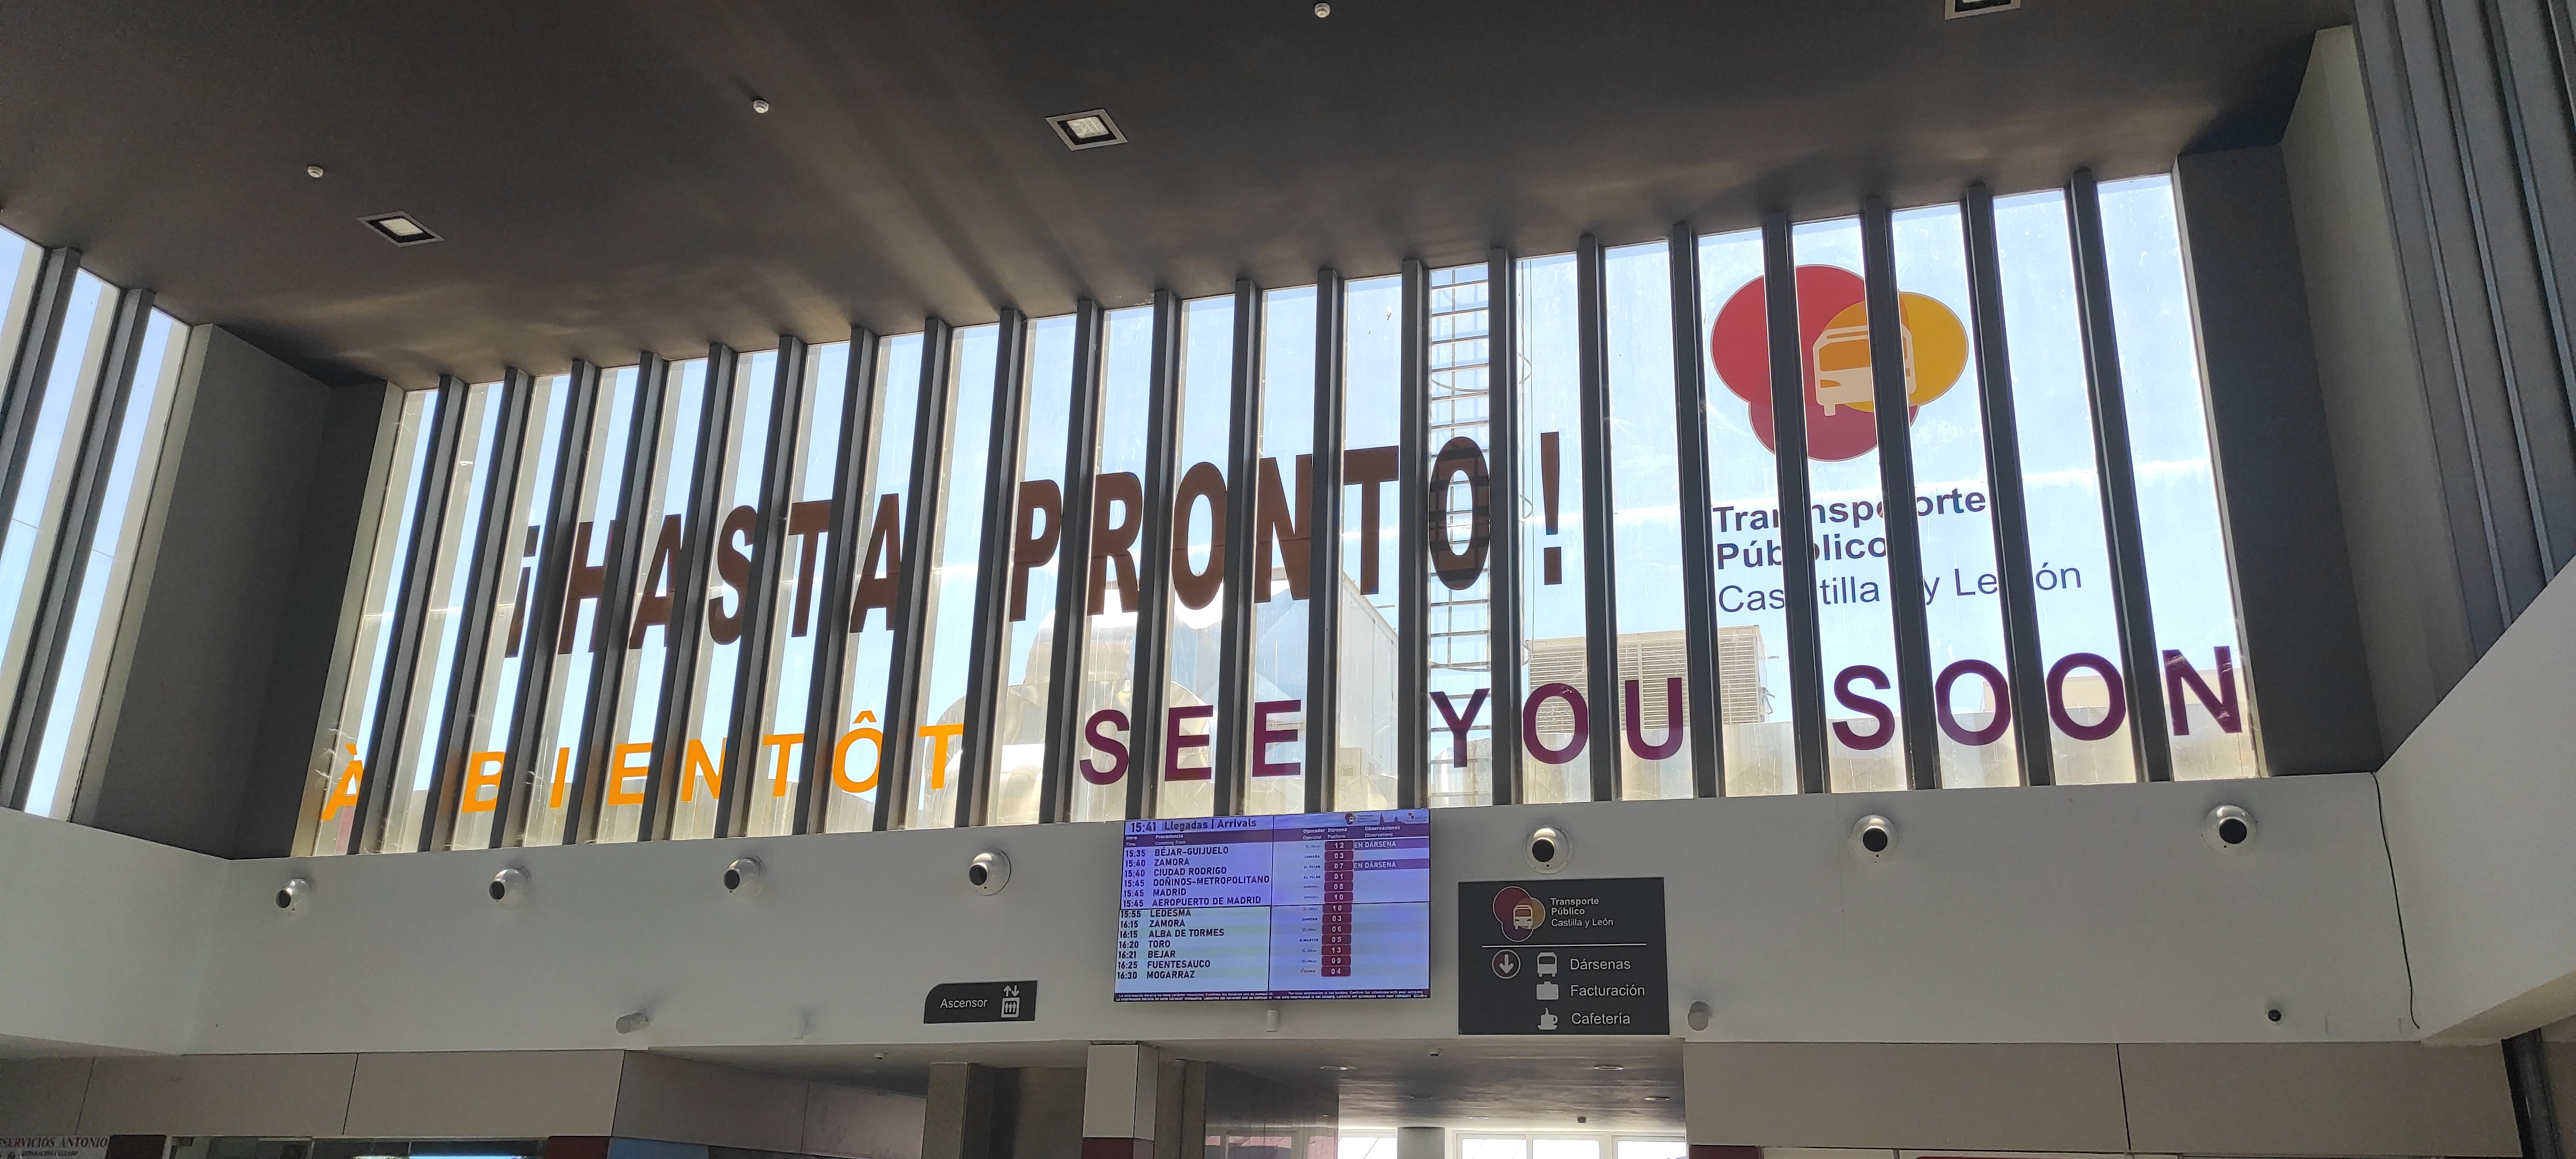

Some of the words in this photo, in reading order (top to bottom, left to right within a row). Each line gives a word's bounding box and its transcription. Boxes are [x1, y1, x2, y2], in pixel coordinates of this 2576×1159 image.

[1718, 576, 1880, 613] Castilla
[1923, 575, 1940, 606] y
[1955, 562, 2081, 596] León
[1079, 699, 1301, 786] SEE
[1430, 677, 1683, 768] YOU
[1832, 646, 2243, 751] SOON
[321, 743, 365, 821] À
[461, 710, 964, 814] BIENTÔT
[1131, 822, 1156, 832] 15:41
[1164, 820, 1208, 832] Llegadas
[1217, 818, 1257, 828] Arrivals
[1154, 846, 1229, 856] BÉJAR-GUIJUELO
[1154, 858, 1190, 866] ZAMORA
[1154, 868, 1185, 876] CIUDAD
[1189, 866, 1227, 875] RODRIGO
[1153, 875, 1270, 886] DOÑINOS-METROPOLITANO
[1153, 888, 1186, 896] MADRID
[1152, 898, 1209, 907] AEROPUERTO
[1227, 896, 1261, 904] MADRID
[1551, 898, 1599, 907] Transporte
[1121, 910, 1141, 918] 15:55
[1150, 909, 1191, 917] LEDESMA
[1551, 907, 1585, 915] Público
[1149, 919, 1185, 928] ZAMORA
[1551, 919, 1582, 927] Castilla
[1584, 920, 1590, 929] y
[1592, 918, 1613, 926] León
[1148, 929, 1172, 938] ALBA
[1189, 928, 1225, 936] TORMES
[1119, 940, 1139, 949] 16:20
[1148, 940, 1170, 948] TORO
[1147, 950, 1176, 959] BEJAR
[1147, 960, 1211, 969] FUENTESAUCO
[1570, 958, 1631, 970] Dársenas
[1117, 971, 1137, 980] 16:30
[1146, 970, 1195, 979] MOGARRAZ
[1571, 984, 1645, 996] Facturación
[940, 998, 988, 1009] Ascensor
[1571, 1012, 1631, 1025] Cafetería
[60, 1136, 108, 1147] ANTONIO
